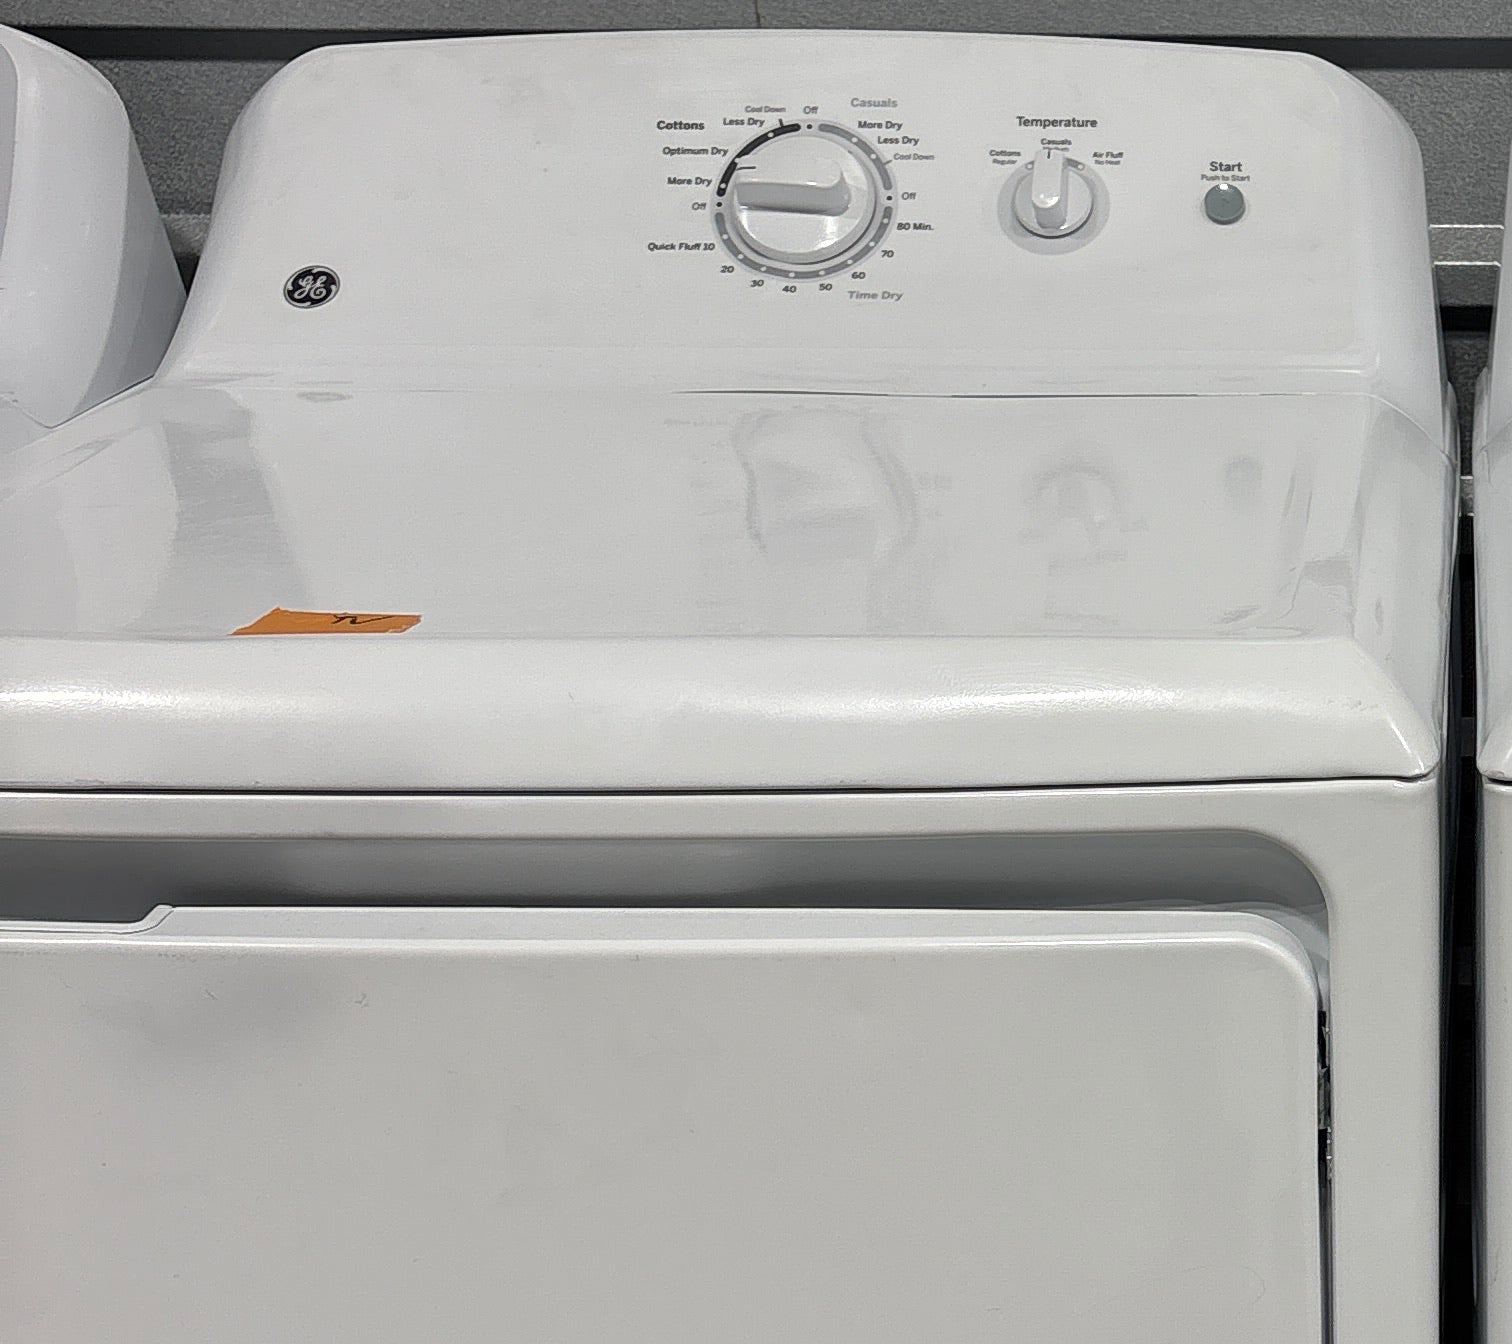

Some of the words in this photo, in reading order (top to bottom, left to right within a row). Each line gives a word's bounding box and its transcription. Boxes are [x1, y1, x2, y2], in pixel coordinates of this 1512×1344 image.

[851, 98, 898, 108] Casuals
[657, 120, 705, 130] Cottons
[723, 118, 745, 126] Less
[747, 118, 765, 128] Dry
[858, 121, 883, 129] More
[885, 121, 903, 131] Dry
[1016, 116, 1098, 129] Temperature
[878, 136, 900, 144] Less
[902, 136, 919, 146] Dry
[662, 147, 708, 156] Optimum
[711, 147, 728, 157] Dry
[1210, 161, 1242, 172] Start
[667, 177, 692, 185] More
[695, 177, 712, 187] Dry
[648, 242, 676, 252] Quick
[703, 243, 715, 251] 10
[881, 250, 894, 258] 70
[720, 265, 734, 273] 20
[750, 279, 764, 287] 30
[819, 283, 832, 291] 50
[848, 291, 878, 299] Time
[881, 291, 903, 302] Dry
